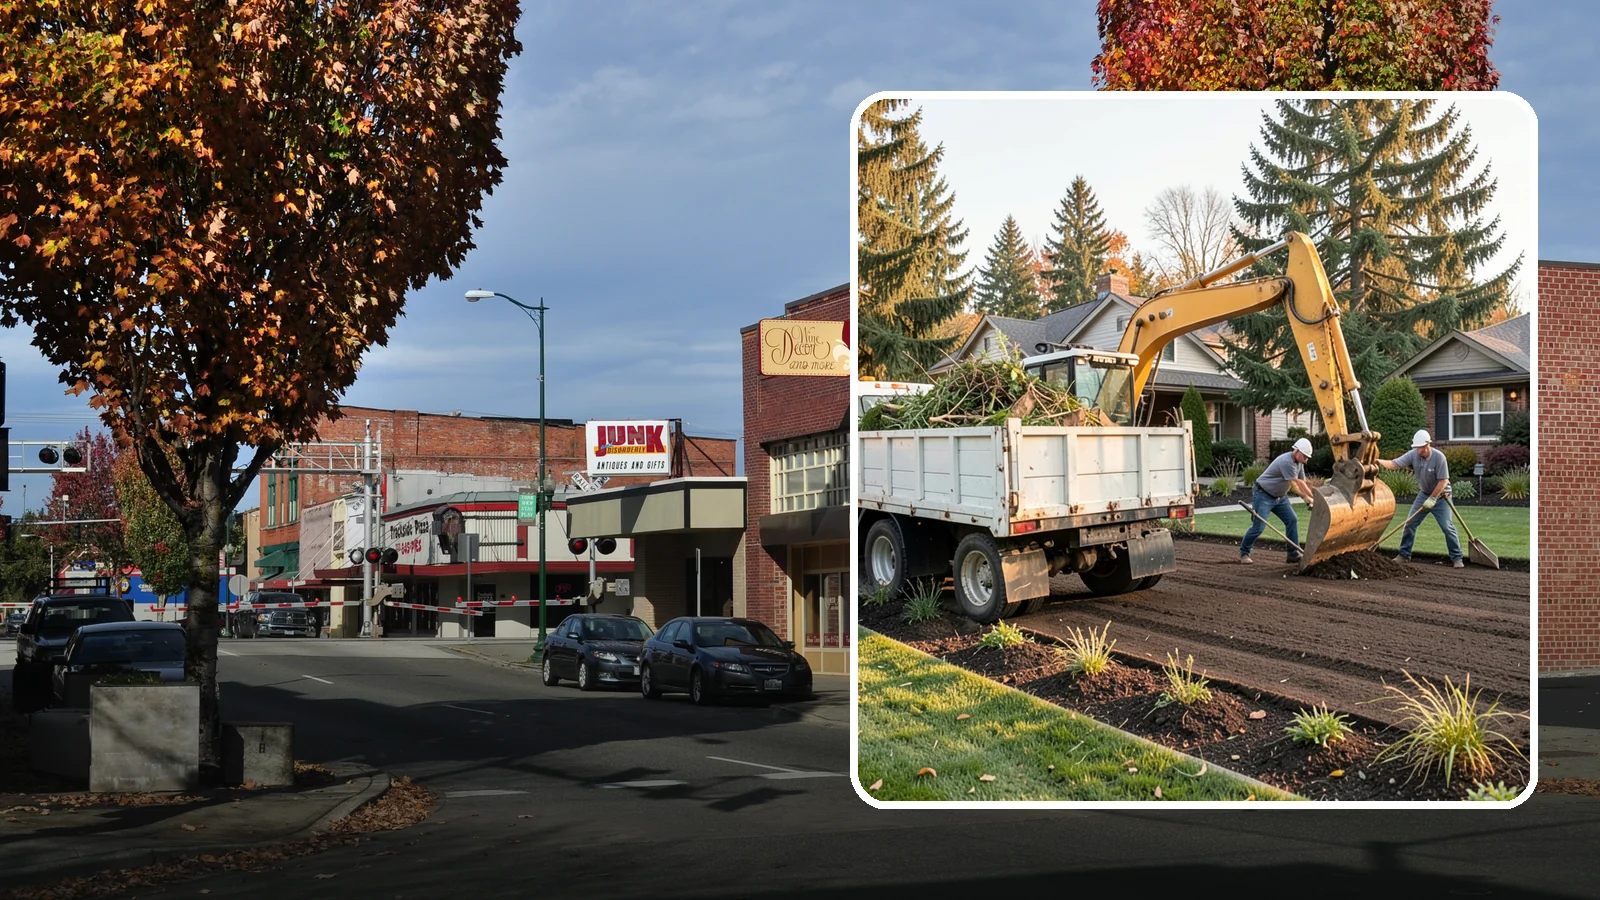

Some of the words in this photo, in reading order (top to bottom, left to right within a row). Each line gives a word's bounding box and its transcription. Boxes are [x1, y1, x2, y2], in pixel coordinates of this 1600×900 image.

[595, 425, 665, 457] JUNK
[607, 446, 646, 454] DISORDERLY
[596, 461, 628, 470] ANTIQUES
[631, 461, 644, 470] AND
[647, 460, 666, 469] GIFTS
[589, 476, 608, 492] SING
[414, 519, 429, 535] Pizza
